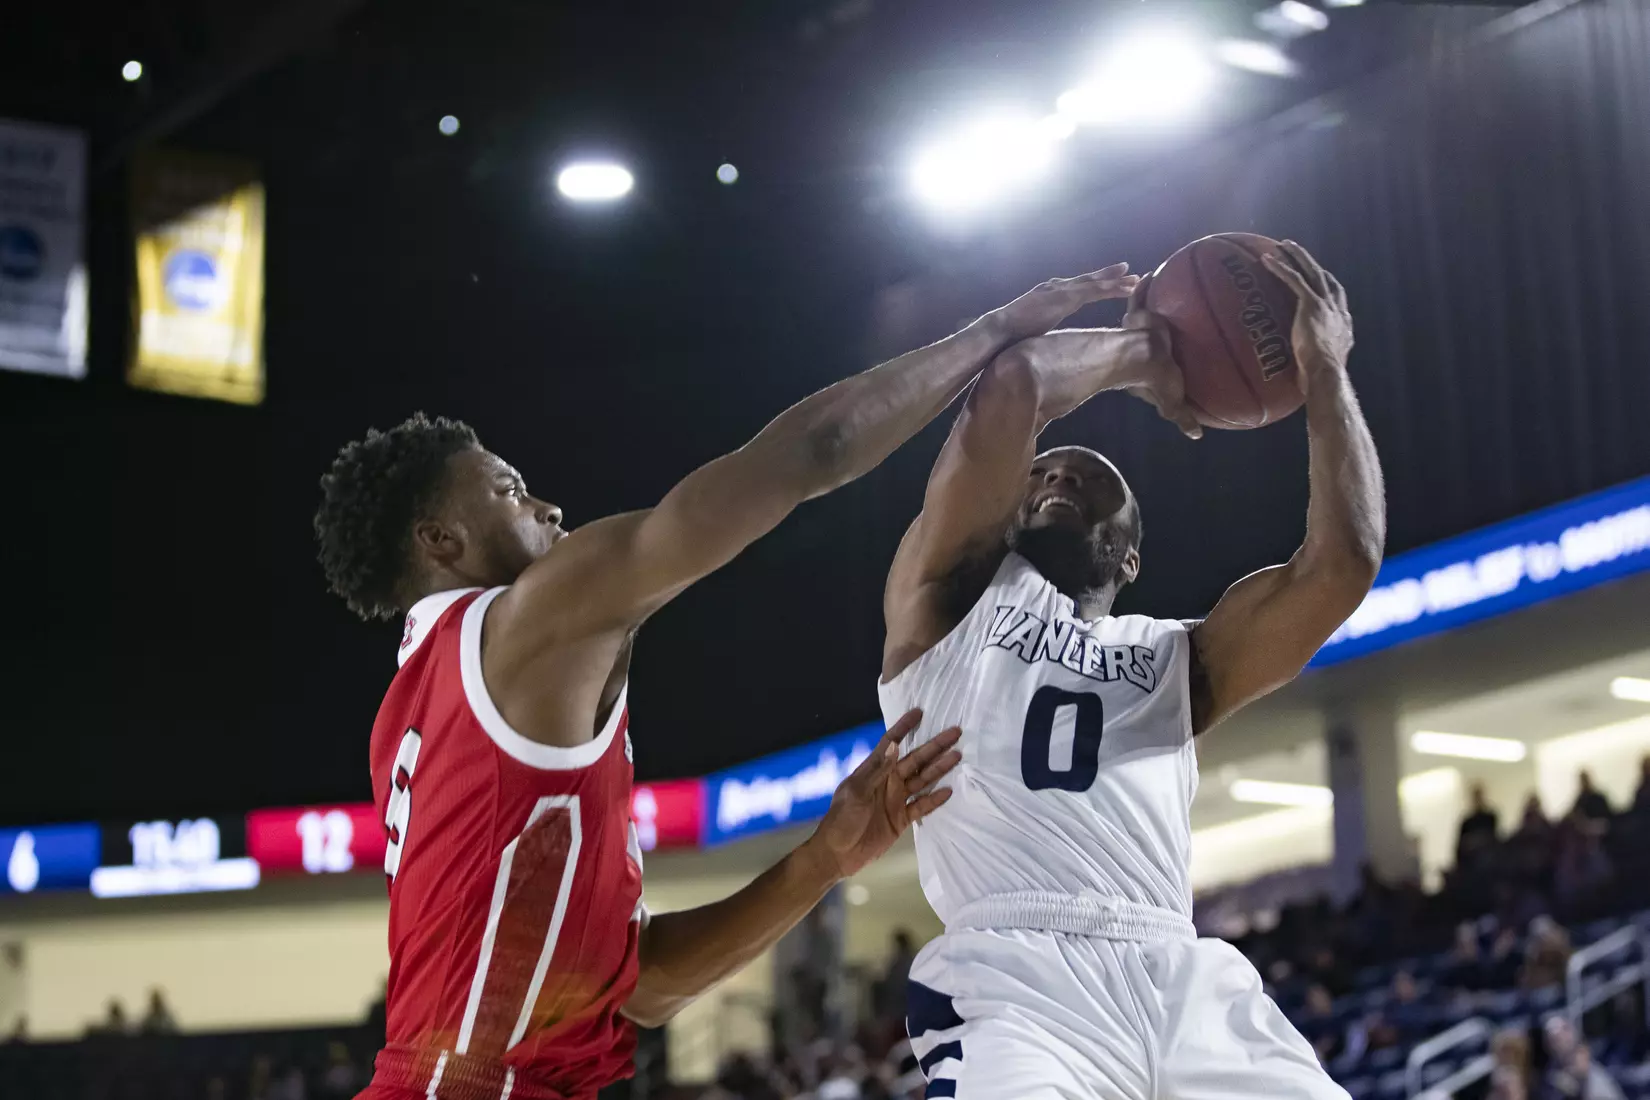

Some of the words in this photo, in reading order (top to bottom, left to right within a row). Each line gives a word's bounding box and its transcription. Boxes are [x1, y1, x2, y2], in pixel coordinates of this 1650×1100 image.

[982, 606, 1156, 694] LANCERS
[1021, 685, 1104, 793] 0
[296, 811, 353, 873] 12
